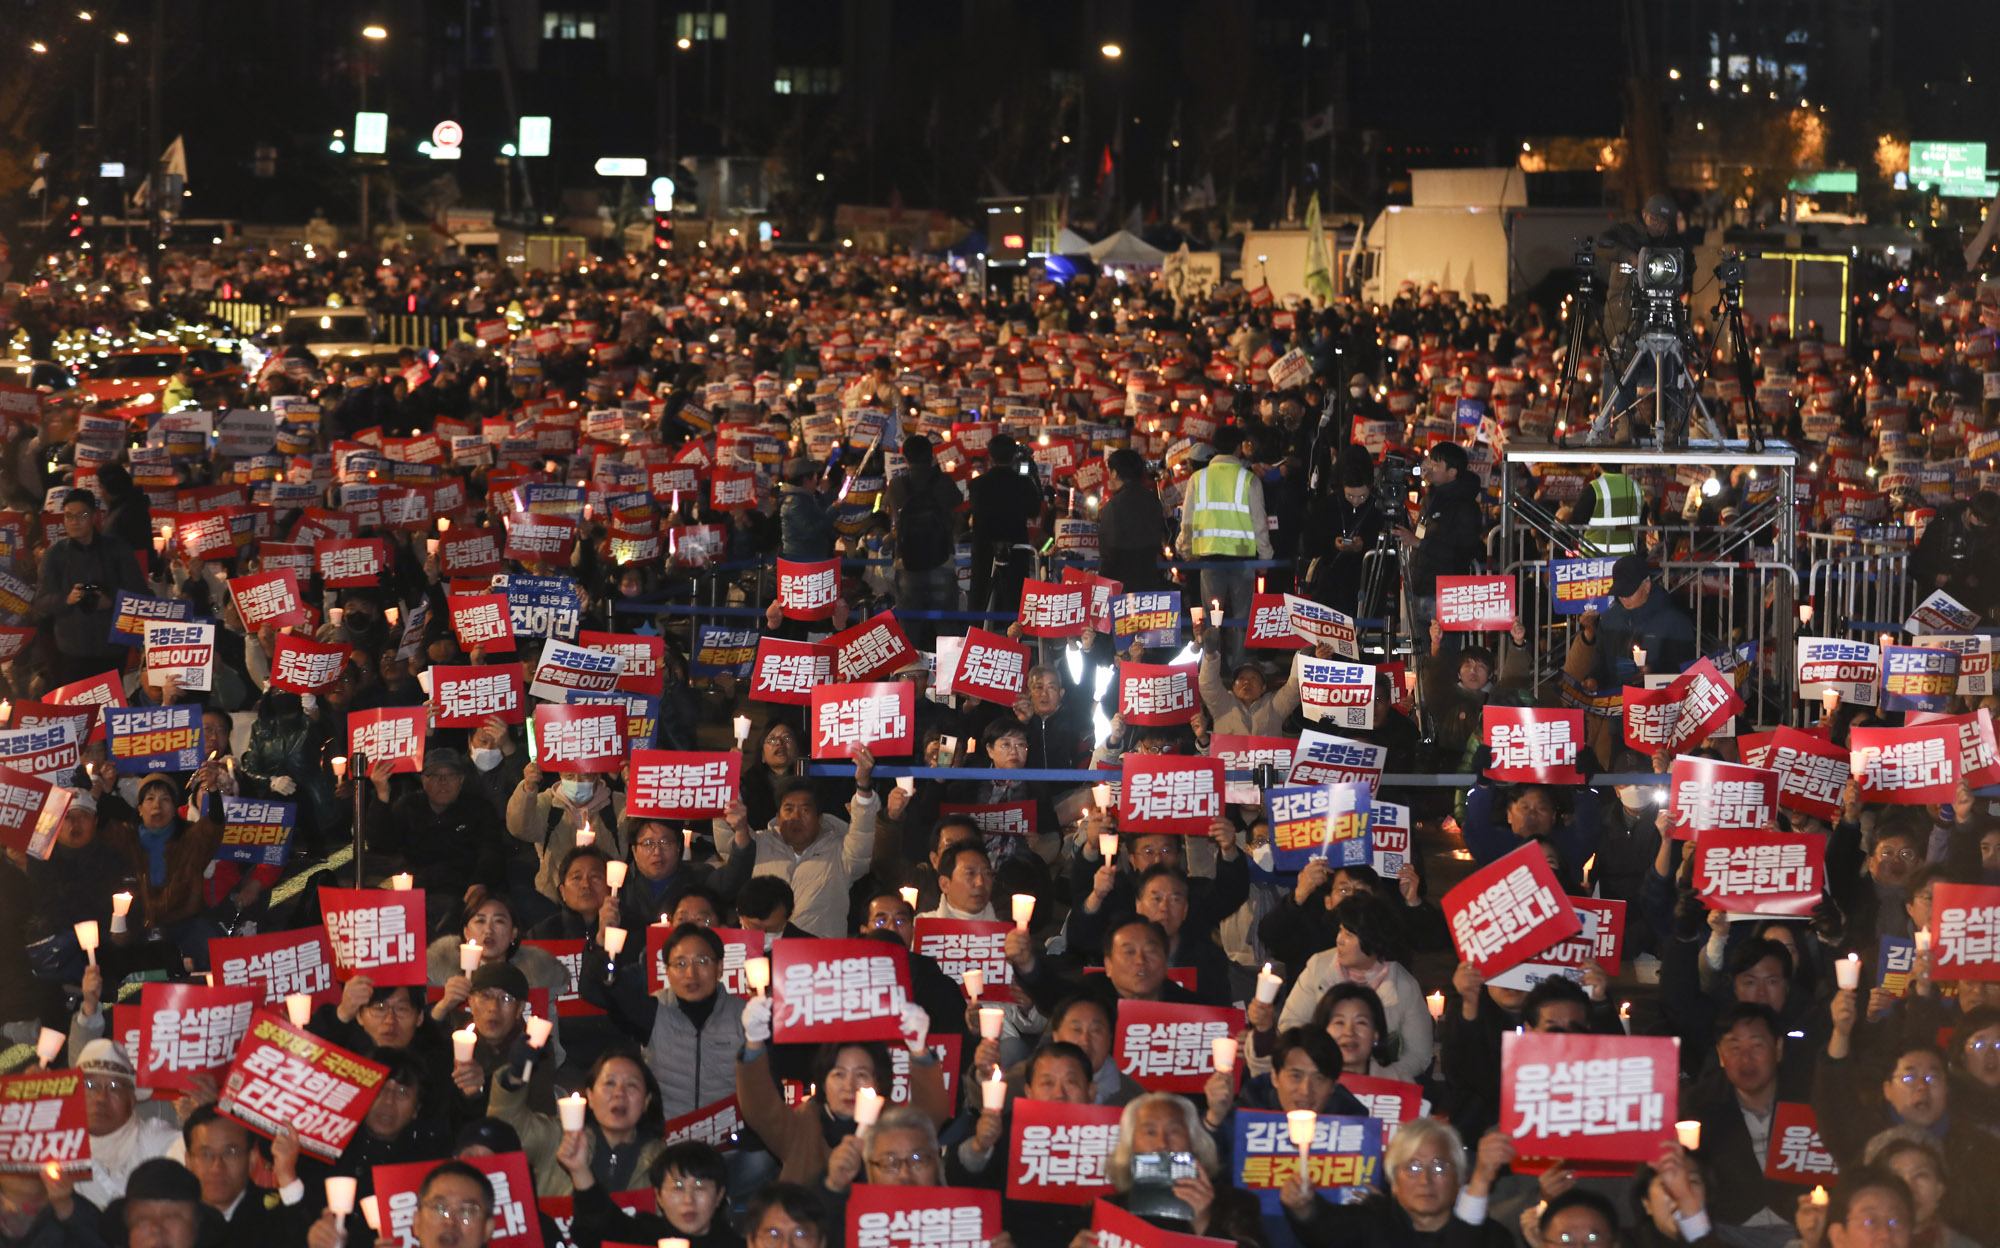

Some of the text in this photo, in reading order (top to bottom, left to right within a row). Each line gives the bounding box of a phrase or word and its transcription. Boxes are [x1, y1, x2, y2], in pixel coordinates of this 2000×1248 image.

[446, 535, 495, 556] 윤석열을
[511, 524, 572, 540] 채상병특검
[320, 546, 374, 567] 윤석열을
[447, 547, 501, 571] 거부한다!
[320, 560, 379, 581] 거부한다!
[780, 568, 835, 593] 윤석열을
[236, 578, 288, 607] 윤석열을
[781, 587, 837, 610] 거부한다!
[1024, 591, 1083, 611] 윤석열을
[1442, 581, 1506, 601] 국정농단
[120, 597, 186, 619] 김건희를
[241, 594, 296, 625] 거부한다!
[454, 603, 499, 627] 윤석열을
[1022, 607, 1086, 628] 거부한다!
[1113, 595, 1172, 618] 김건희를
[1293, 602, 1345, 626] 국정농단
[1441, 600, 1510, 623] 규명하라!
[149, 627, 203, 645] 국정농단
[457, 619, 507, 644] 거부한다!
[1115, 611, 1178, 638] 특검하라!
[1323, 622, 1353, 640] OUT!
[170, 648, 208, 666] OUT!
[838, 624, 893, 667] 윤석열을
[970, 645, 1024, 671] 윤석열을
[1806, 644, 1870, 661] 국정농단
[280, 650, 344, 671] 윤석열을
[551, 649, 616, 672] 국정농단
[760, 654, 831, 673] 윤석열을
[839, 635, 906, 684] 거부한다!
[1801, 665, 1874, 681] 윤석열 OUT!
[1889, 653, 1956, 674] 김건희를
[276, 664, 343, 689] 거부한다!
[440, 673, 512, 700] 윤석열을
[539, 667, 616, 690] 윤석열 OUT!
[959, 662, 1025, 693] 거부한다!
[1123, 671, 1188, 697] 윤석열을
[1303, 664, 1364, 684] 국정농단
[440, 690, 517, 718] 거부한다!
[1122, 688, 1194, 716] 거부한다!
[1301, 685, 1329, 704] 윤석열
[1329, 682, 1369, 704] OUT!
[111, 710, 190, 735] 김건희를
[819, 693, 900, 726] 윤석열을
[111, 726, 200, 757] 특검하라!
[352, 717, 414, 748] 윤석열을
[543, 715, 617, 743] 윤석열을
[818, 715, 906, 748] 거부한다!
[1490, 719, 1570, 747] 윤석열을
[34, 747, 75, 771] OUT!
[543, 734, 623, 763] 거부한다!
[1307, 740, 1379, 768] 국정농단
[1490, 743, 1577, 770] 거부한다!
[1862, 738, 1946, 769] 윤석열을
[637, 762, 729, 788] 국정농단
[1770, 747, 1851, 784] 윤석열을
[1862, 763, 1953, 792] 거부한다!
[1130, 769, 1215, 795] 윤석열을
[1677, 780, 1765, 806] 윤석열을
[635, 786, 732, 809] 규명하라!
[1127, 793, 1220, 822] 거부한다!
[1270, 789, 1357, 822] 김건희를
[1273, 812, 1368, 850] 특검하라!
[1704, 844, 1807, 872] 윤석열을
[1702, 867, 1813, 896] 거부한다!
[1452, 865, 1537, 937] 윤석열을
[326, 905, 406, 942] 윤석열을
[1459, 886, 1561, 964] 거부한다!
[223, 940, 321, 984] 윤석열을
[785, 956, 897, 996] 윤석열을
[152, 1001, 253, 1041] 윤석열을
[1124, 1022, 1230, 1051] 윤석열을
[242, 1044, 361, 1113] 윤건희를
[1514, 1056, 1655, 1102] 윤석열을
[0, 1098, 64, 1132] 희를
[237, 1077, 359, 1145] 타도하자!
[1512, 1093, 1663, 1139] 거부한다!
[1245, 1122, 1364, 1153] 김건희를
[857, 1206, 983, 1243] 윤석열을
